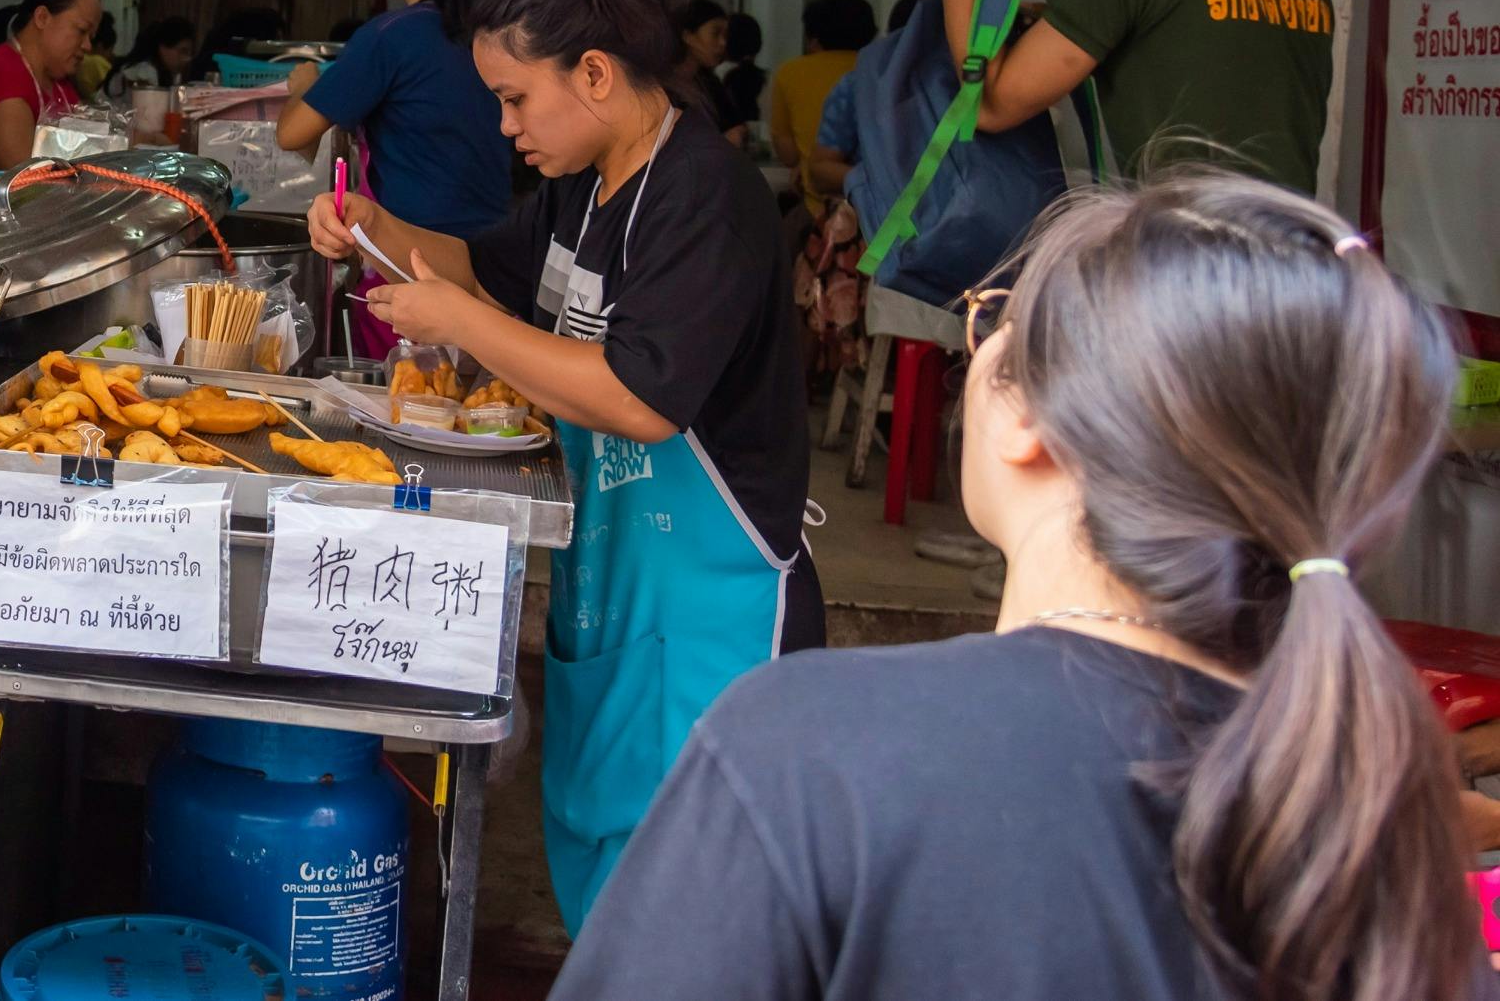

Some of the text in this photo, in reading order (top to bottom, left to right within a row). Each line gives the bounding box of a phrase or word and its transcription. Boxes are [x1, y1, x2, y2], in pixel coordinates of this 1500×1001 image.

[603, 458, 645, 487] NOW
[79, 609, 99, 629] ณ
[108, 594, 181, 632] ที่นี้ด้วย
[332, 618, 419, 673] โจ๊กหมู
[373, 853, 398, 874] Gas
[282, 883, 320, 893] ORCHID
[323, 883, 342, 893] GAS
